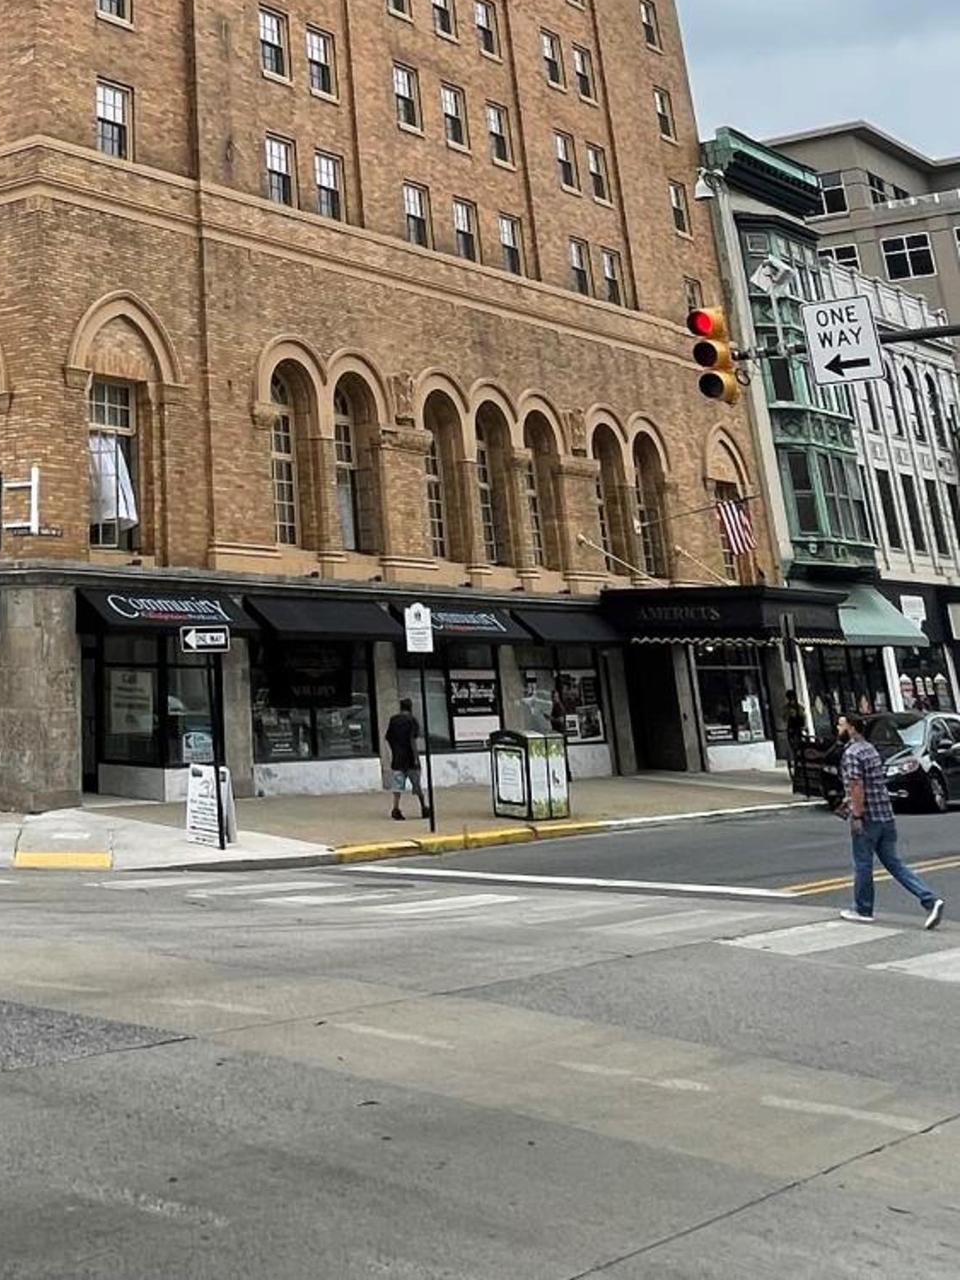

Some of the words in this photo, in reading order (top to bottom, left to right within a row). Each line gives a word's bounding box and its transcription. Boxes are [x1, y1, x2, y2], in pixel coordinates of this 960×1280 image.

[816, 305, 858, 327] ONE
[818, 326, 861, 348] WAY
[107, 594, 232, 621] Community
[640, 605, 721, 621] AMERICUS
